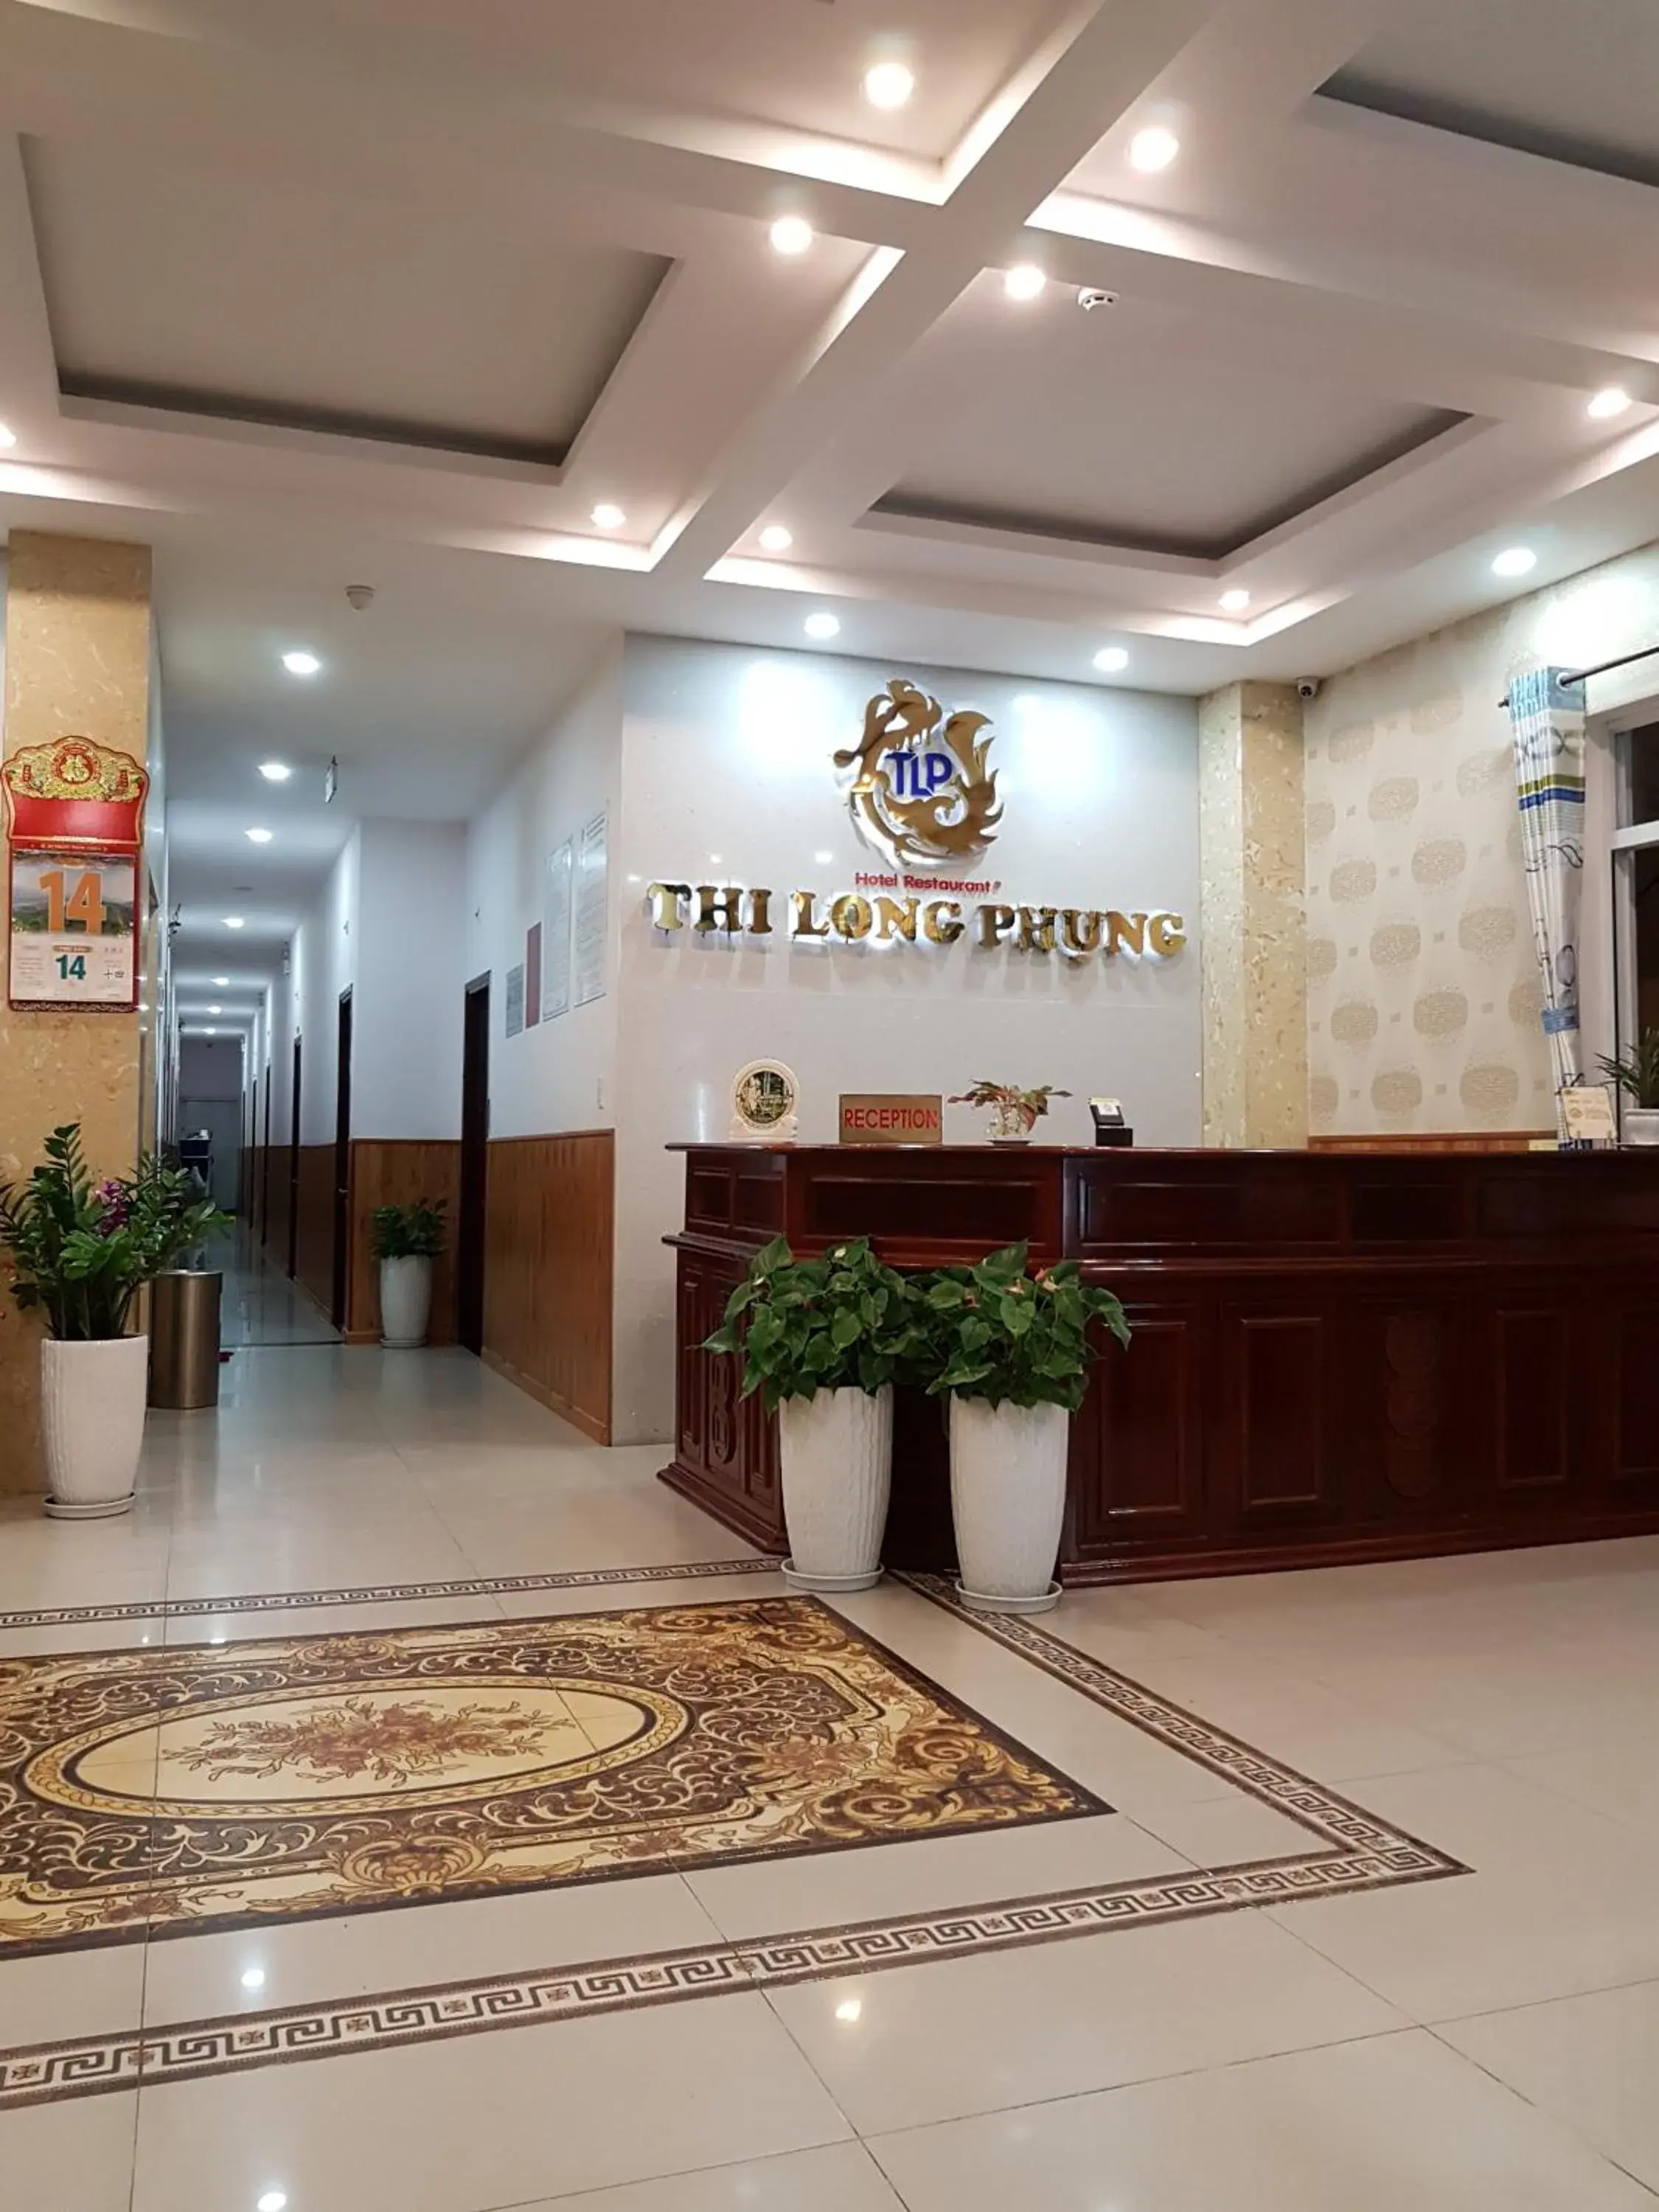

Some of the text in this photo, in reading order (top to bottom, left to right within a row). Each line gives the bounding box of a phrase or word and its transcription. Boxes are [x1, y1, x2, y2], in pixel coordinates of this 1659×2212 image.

[885, 751, 953, 797] TLP
[855, 872, 991, 893] Hotel Restaurant
[38, 870, 106, 936] 14
[647, 883, 772, 933] THI
[789, 891, 964, 945] LONG
[55, 954, 86, 980] 14
[844, 1108, 939, 1129] RECEPTION
